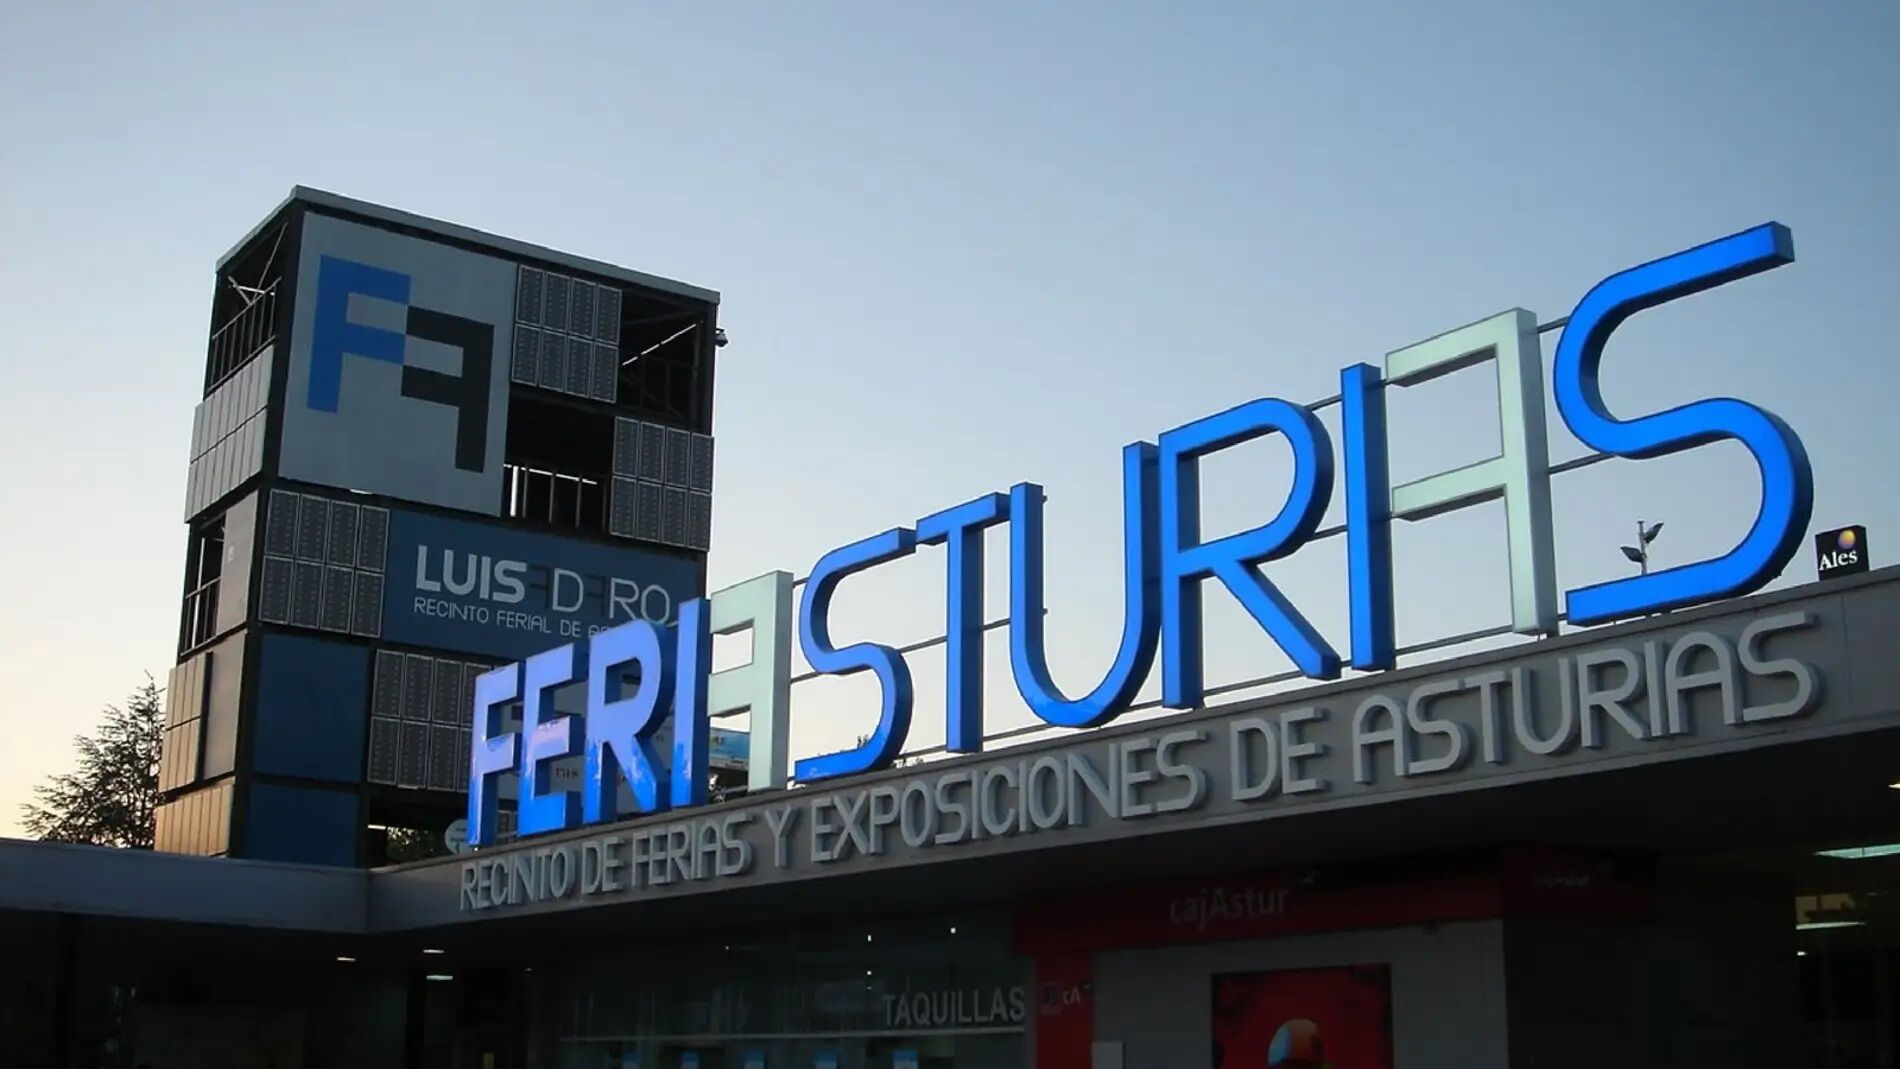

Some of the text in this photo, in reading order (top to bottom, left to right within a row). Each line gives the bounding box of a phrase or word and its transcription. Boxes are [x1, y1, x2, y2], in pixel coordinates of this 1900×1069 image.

[416, 545, 527, 604] LUIS
[1819, 549, 1858, 571] Ales
[414, 597, 489, 624] RECINTO
[496, 610, 551, 634] FERIAL
[560, 619, 581, 638] DE
[460, 611, 1820, 911] RECINTO DE FERIAS Y EXPOSICIONES DE ASTURIAS
[1169, 885, 1289, 932] cajAstur
[881, 986, 1025, 1026] TAQUILLAS
